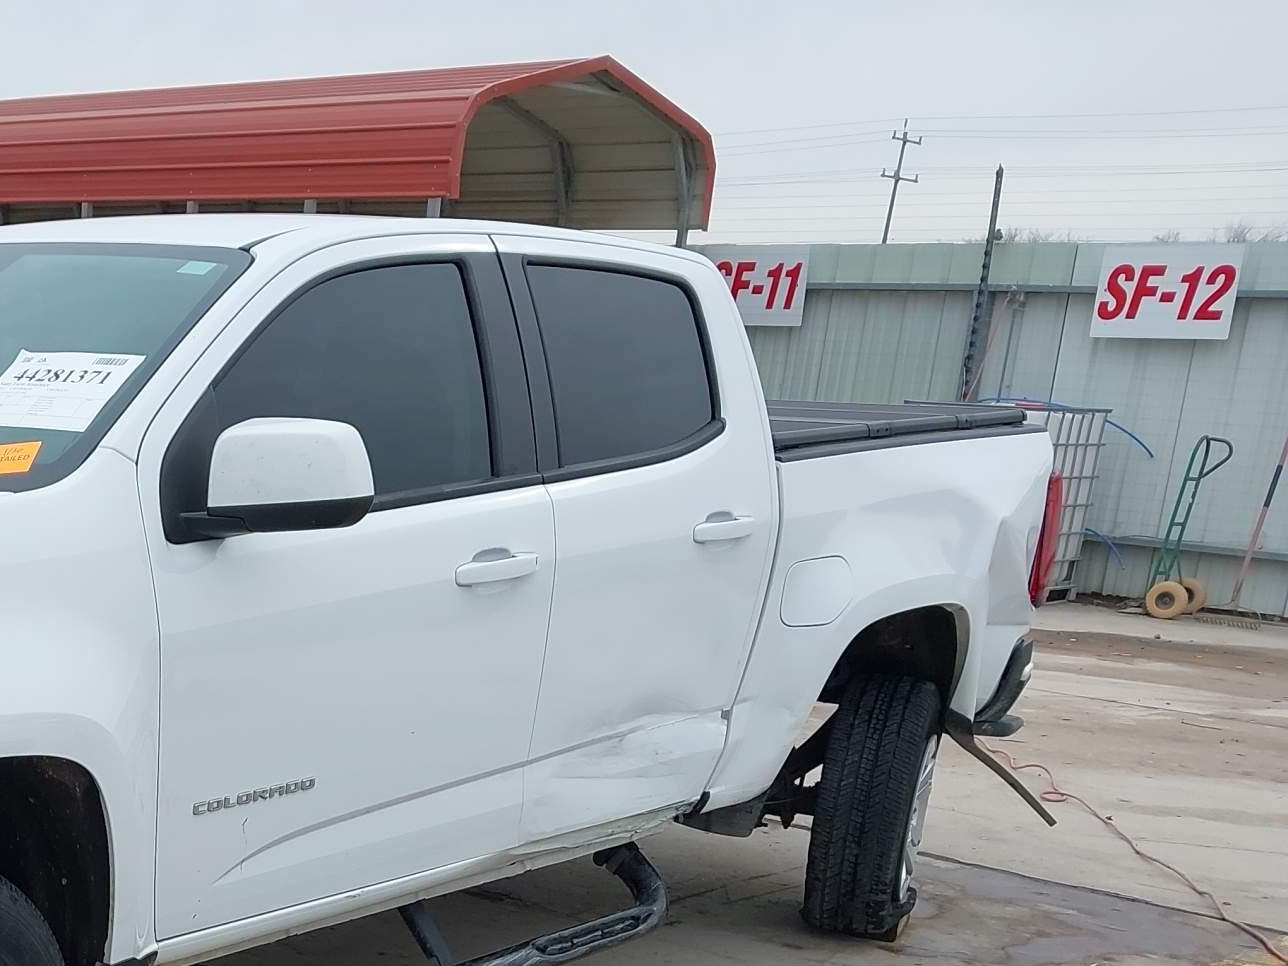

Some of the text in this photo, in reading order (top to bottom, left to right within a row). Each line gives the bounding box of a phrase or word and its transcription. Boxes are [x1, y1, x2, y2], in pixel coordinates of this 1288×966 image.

[1097, 263, 1237, 321] SF-12
[13, 368, 113, 385] 44281371
[192, 776, 316, 816] COLORADO
